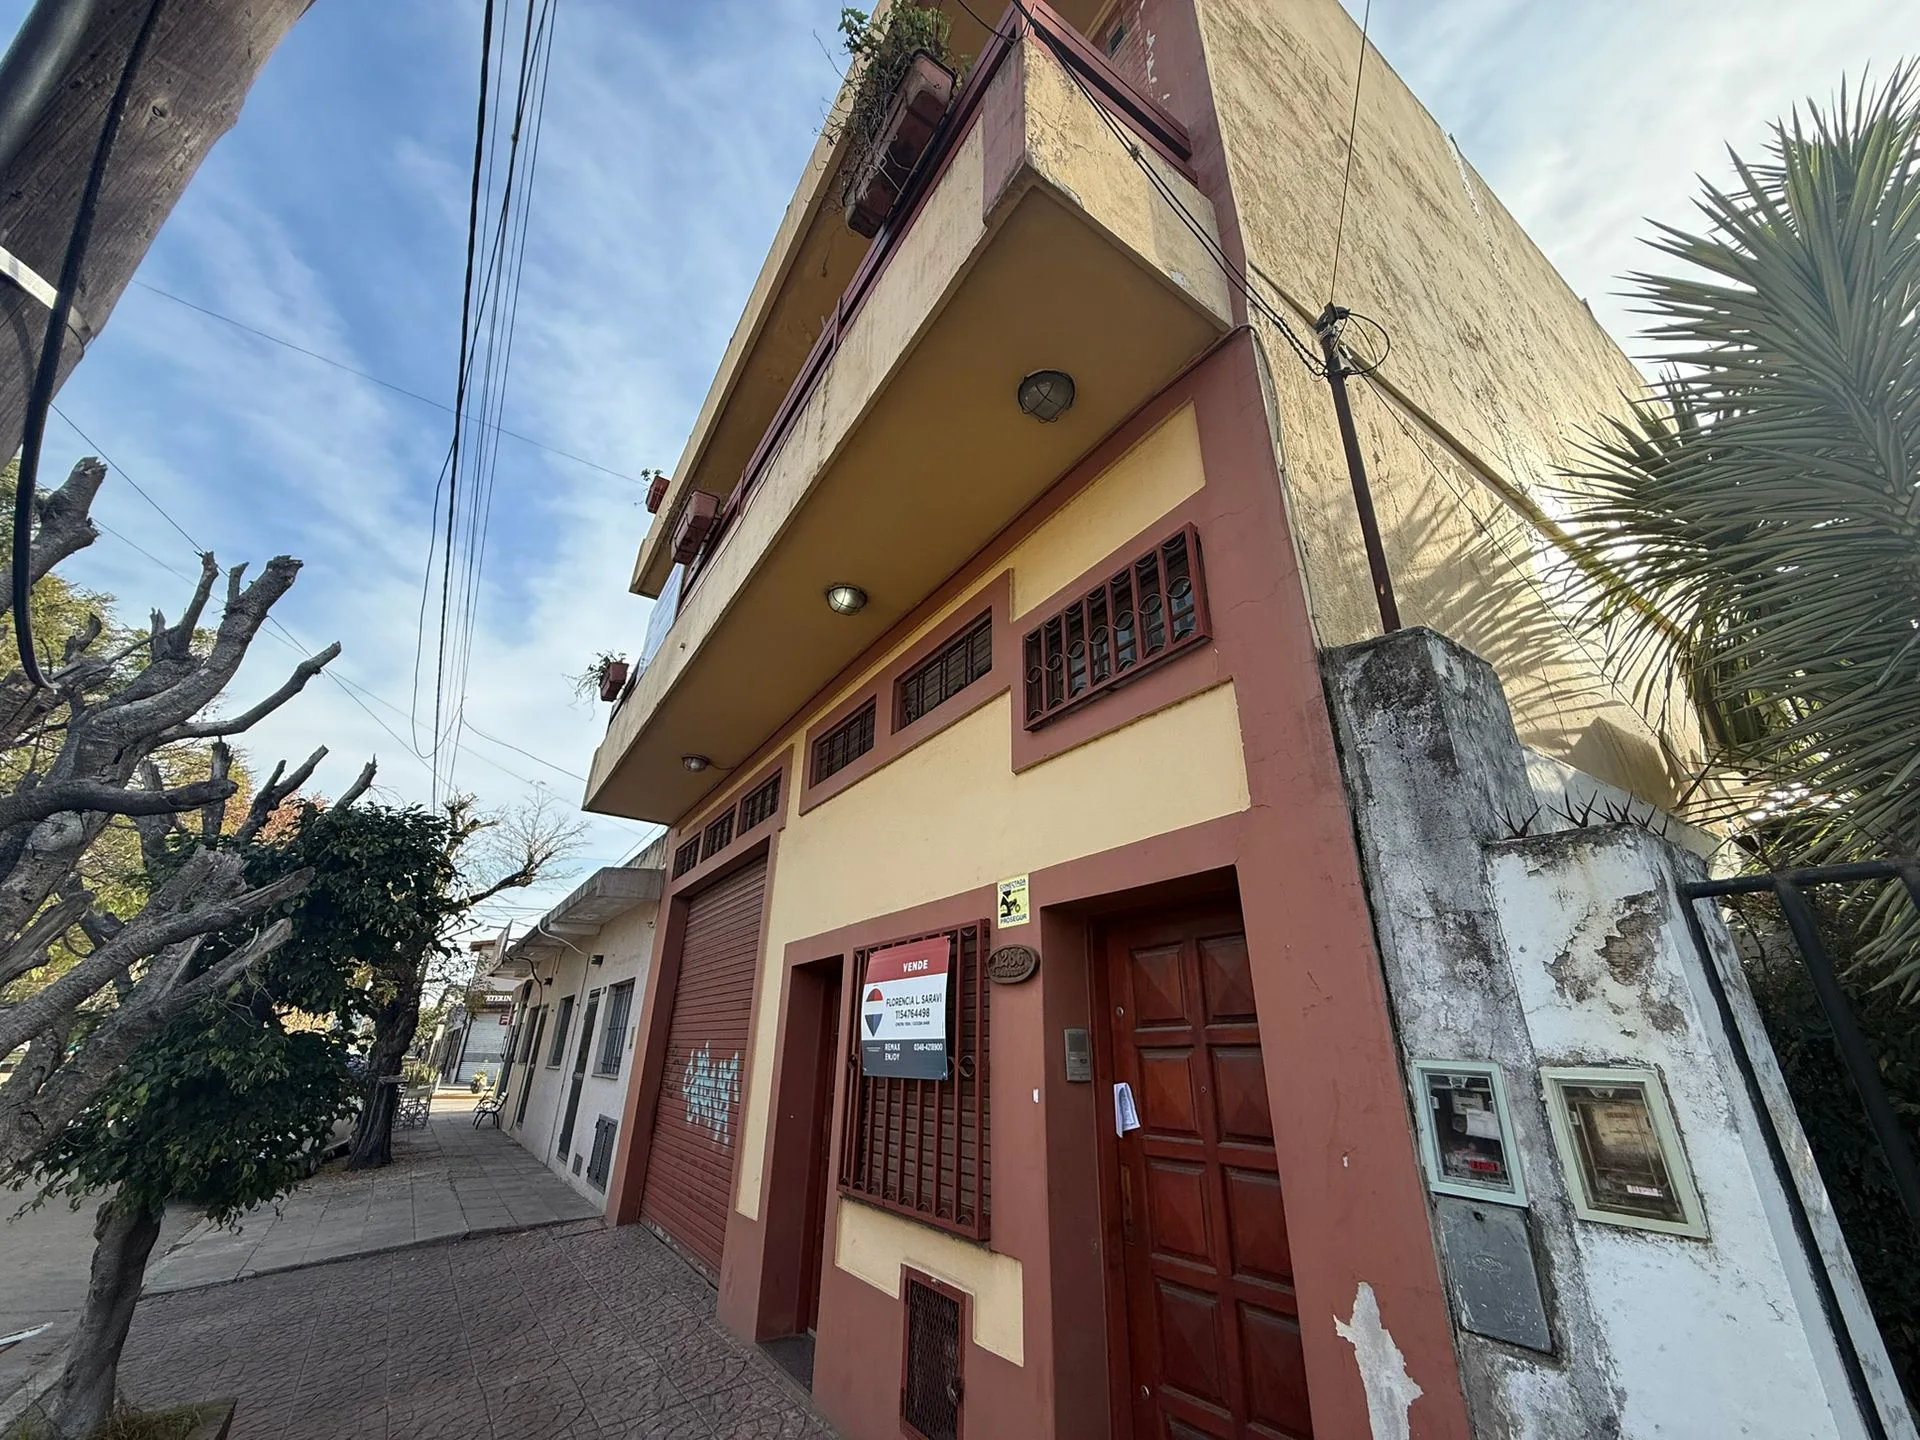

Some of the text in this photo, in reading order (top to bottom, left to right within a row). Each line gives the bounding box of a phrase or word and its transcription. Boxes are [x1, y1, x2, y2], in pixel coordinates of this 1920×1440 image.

[1000, 913, 1027, 924] PROSEGUR
[903, 959, 928, 972] VENDE
[886, 995, 914, 1008] FLORENCIA
[922, 993, 943, 1004] SARAVI
[895, 1007, 931, 1019] 1154764498
[884, 1042, 900, 1051] REMAX
[884, 1052, 900, 1061] ENJOY
